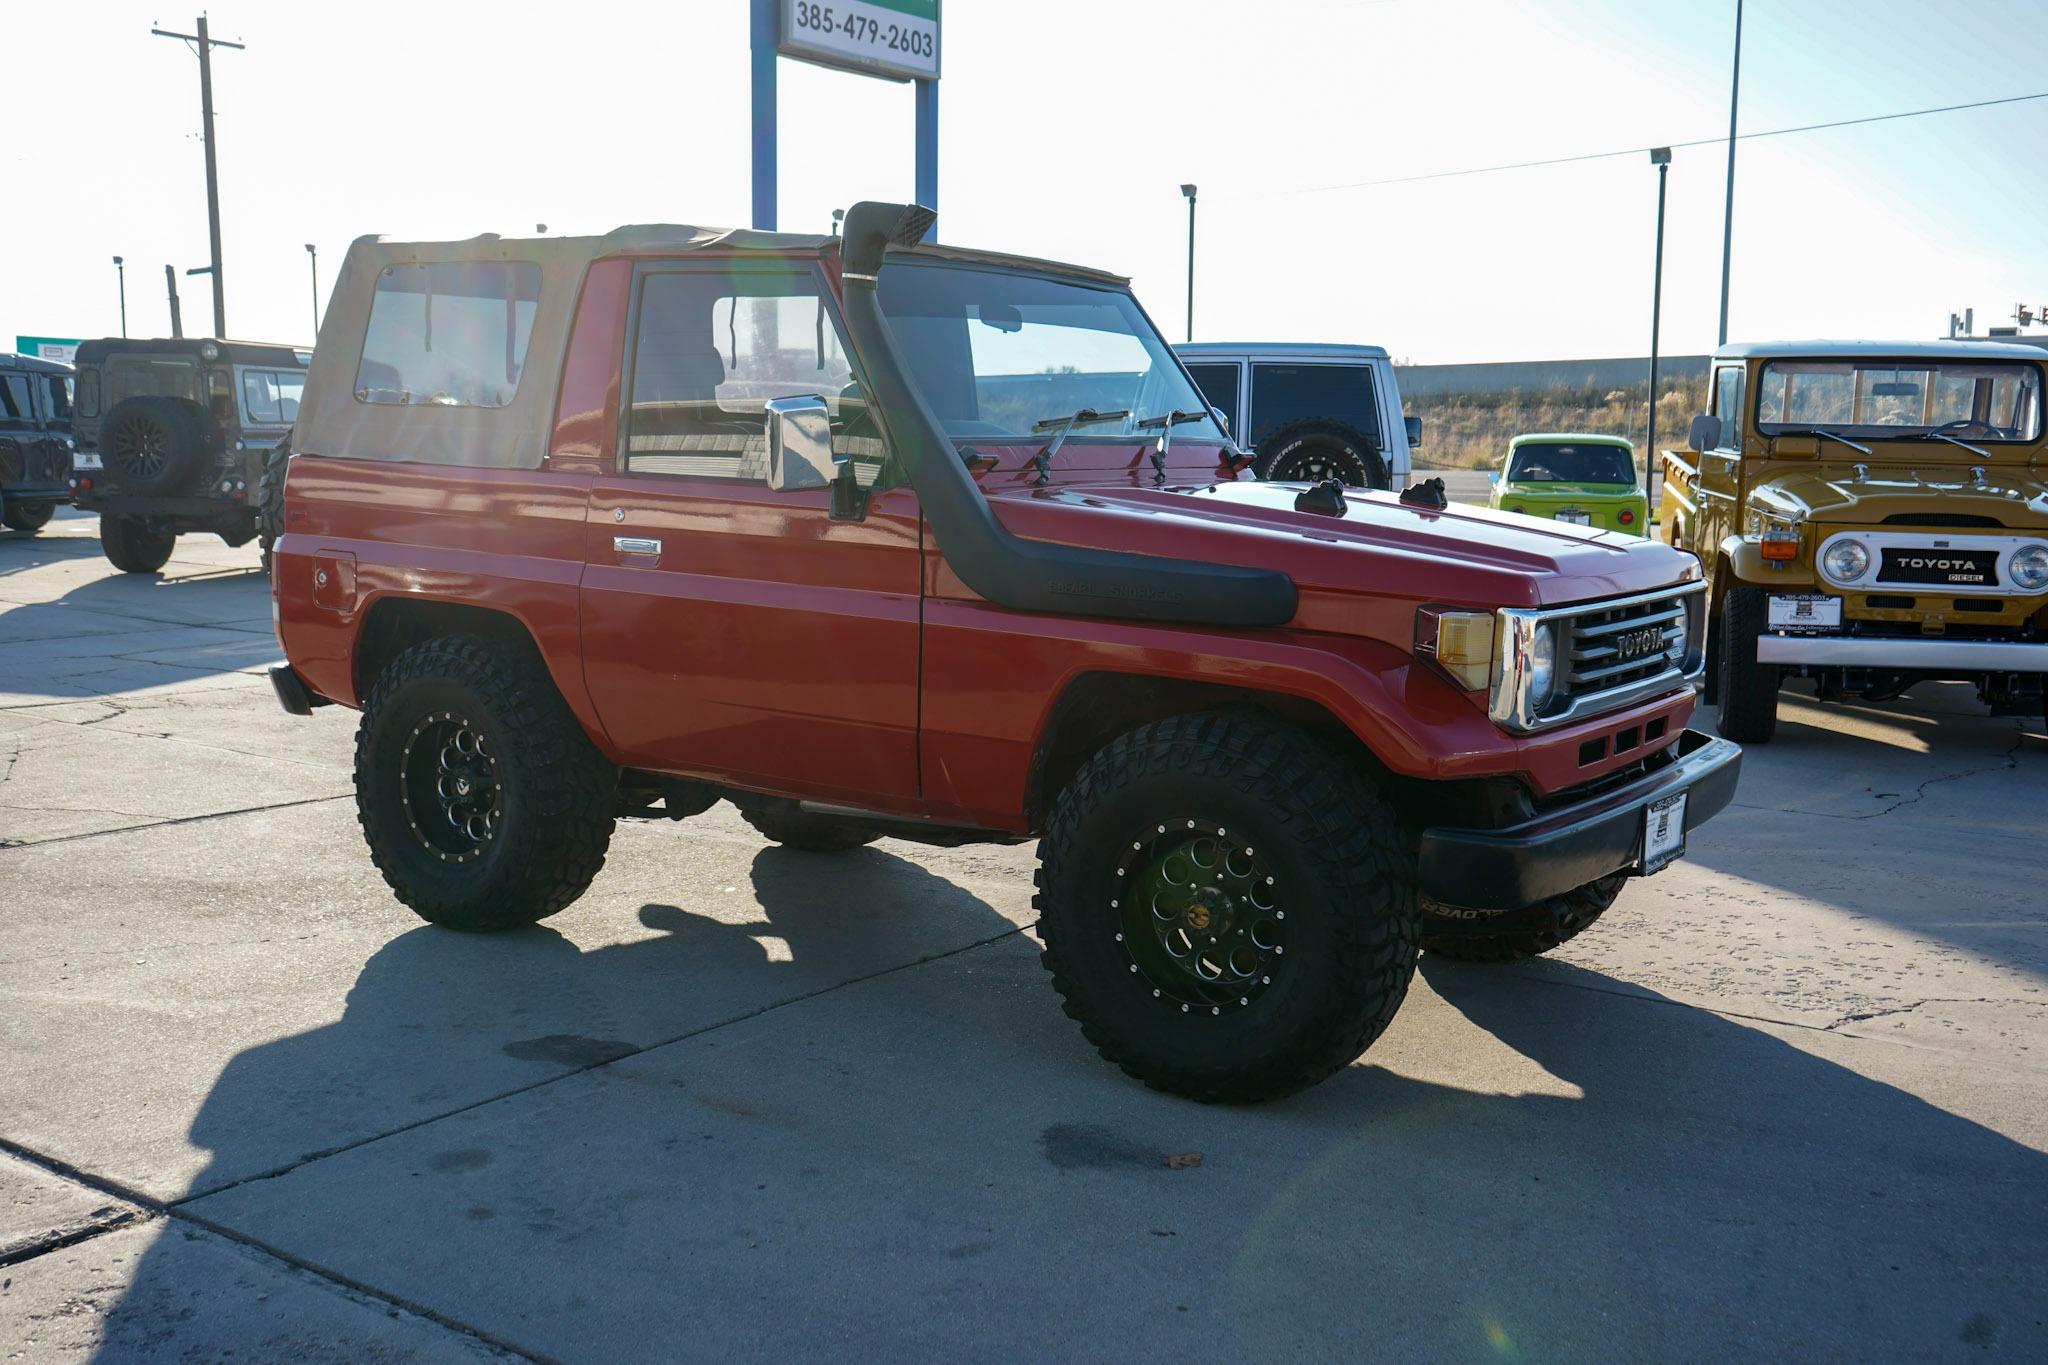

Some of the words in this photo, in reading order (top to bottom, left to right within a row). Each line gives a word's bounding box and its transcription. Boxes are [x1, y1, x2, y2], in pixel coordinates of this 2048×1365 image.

[796, 2, 932, 58] 385-479-2603
[1343, 447, 1364, 467] STT
[1896, 557, 1976, 570] TOYOTA
[1949, 573, 1984, 582] DIESEL
[1616, 626, 1664, 659] TOYOTA
